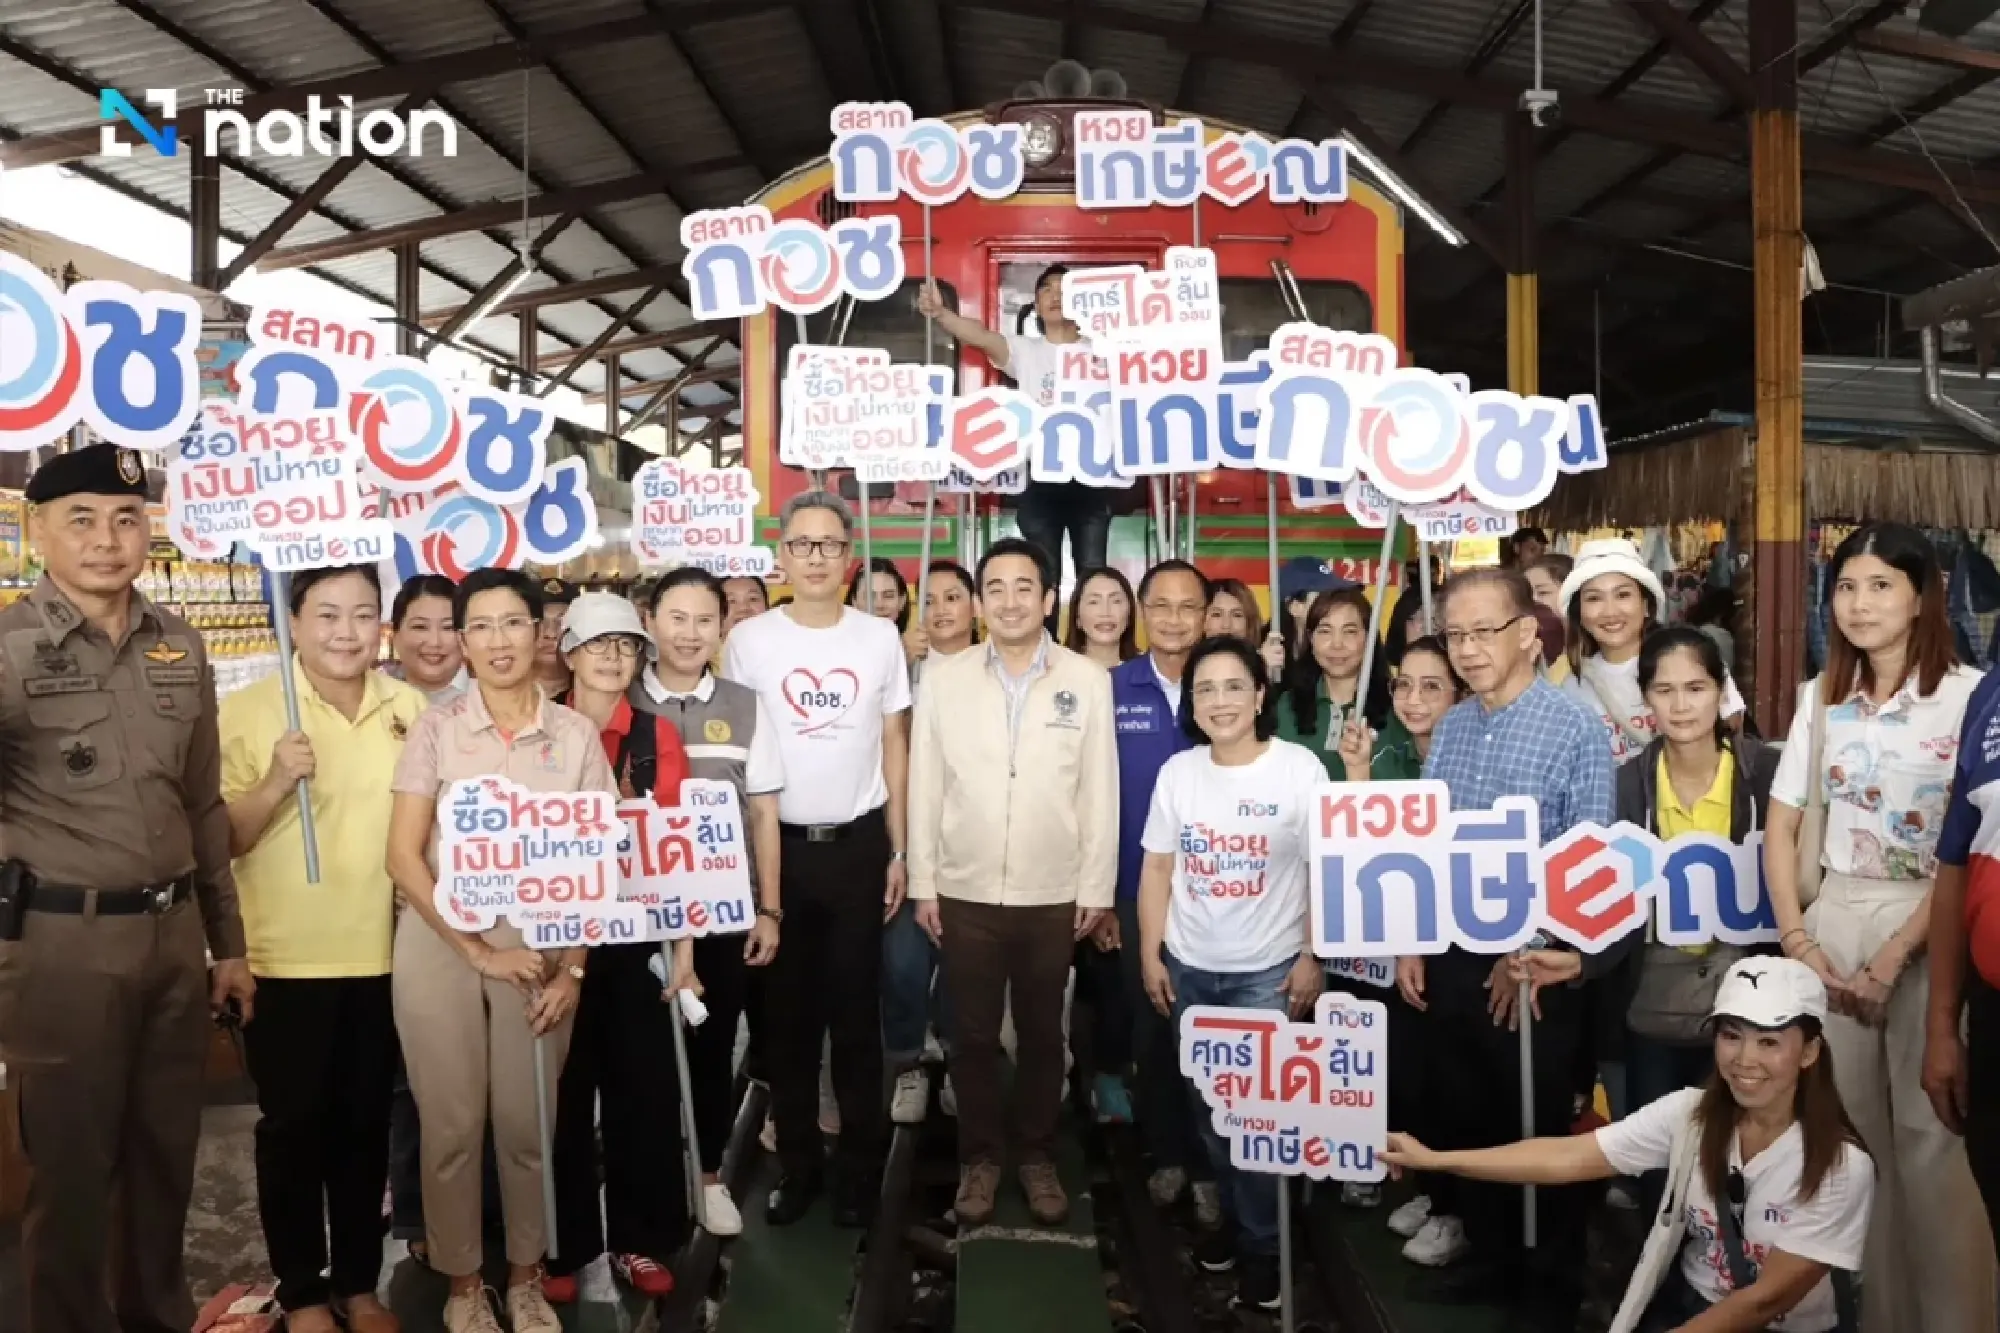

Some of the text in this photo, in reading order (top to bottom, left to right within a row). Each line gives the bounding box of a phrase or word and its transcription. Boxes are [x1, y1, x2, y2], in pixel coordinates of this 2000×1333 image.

[838, 110, 906, 129] สลาก
[1081, 117, 1146, 142] หวย
[837, 126, 1020, 195] กอช
[1081, 126, 1342, 200] เกษียณ
[690, 214, 765, 243] สลาก
[692, 224, 895, 311] กอช
[1072, 283, 1120, 317] ศุกร์
[262, 308, 375, 360] สลาก
[1091, 311, 1120, 337] สุข
[1119, 348, 1207, 385] หวย
[1281, 335, 1384, 375] สลาก
[1120, 360, 1272, 465] เกษี
[1268, 375, 1555, 496] กอช
[276, 535, 381, 566] เกษียณ
[800, 691, 847, 708] กอช.
[698, 815, 733, 853] ลุ้น
[1320, 793, 1437, 838] หวย
[702, 855, 737, 871] ออม
[1322, 809, 1777, 942] เกษียณ
[537, 913, 635, 942] เกษียณ
[1329, 1009, 1373, 1028] กอช
[1192, 1033, 1252, 1078] ศุกร์
[1193, 1017, 1323, 1103] ได้
[1330, 1038, 1373, 1087] ลุ้น
[1213, 1072, 1252, 1109] สุข
[1329, 1089, 1374, 1108] ออม
[1224, 1113, 1276, 1131] กับหวย
[1243, 1126, 1374, 1170] เกษียณ
